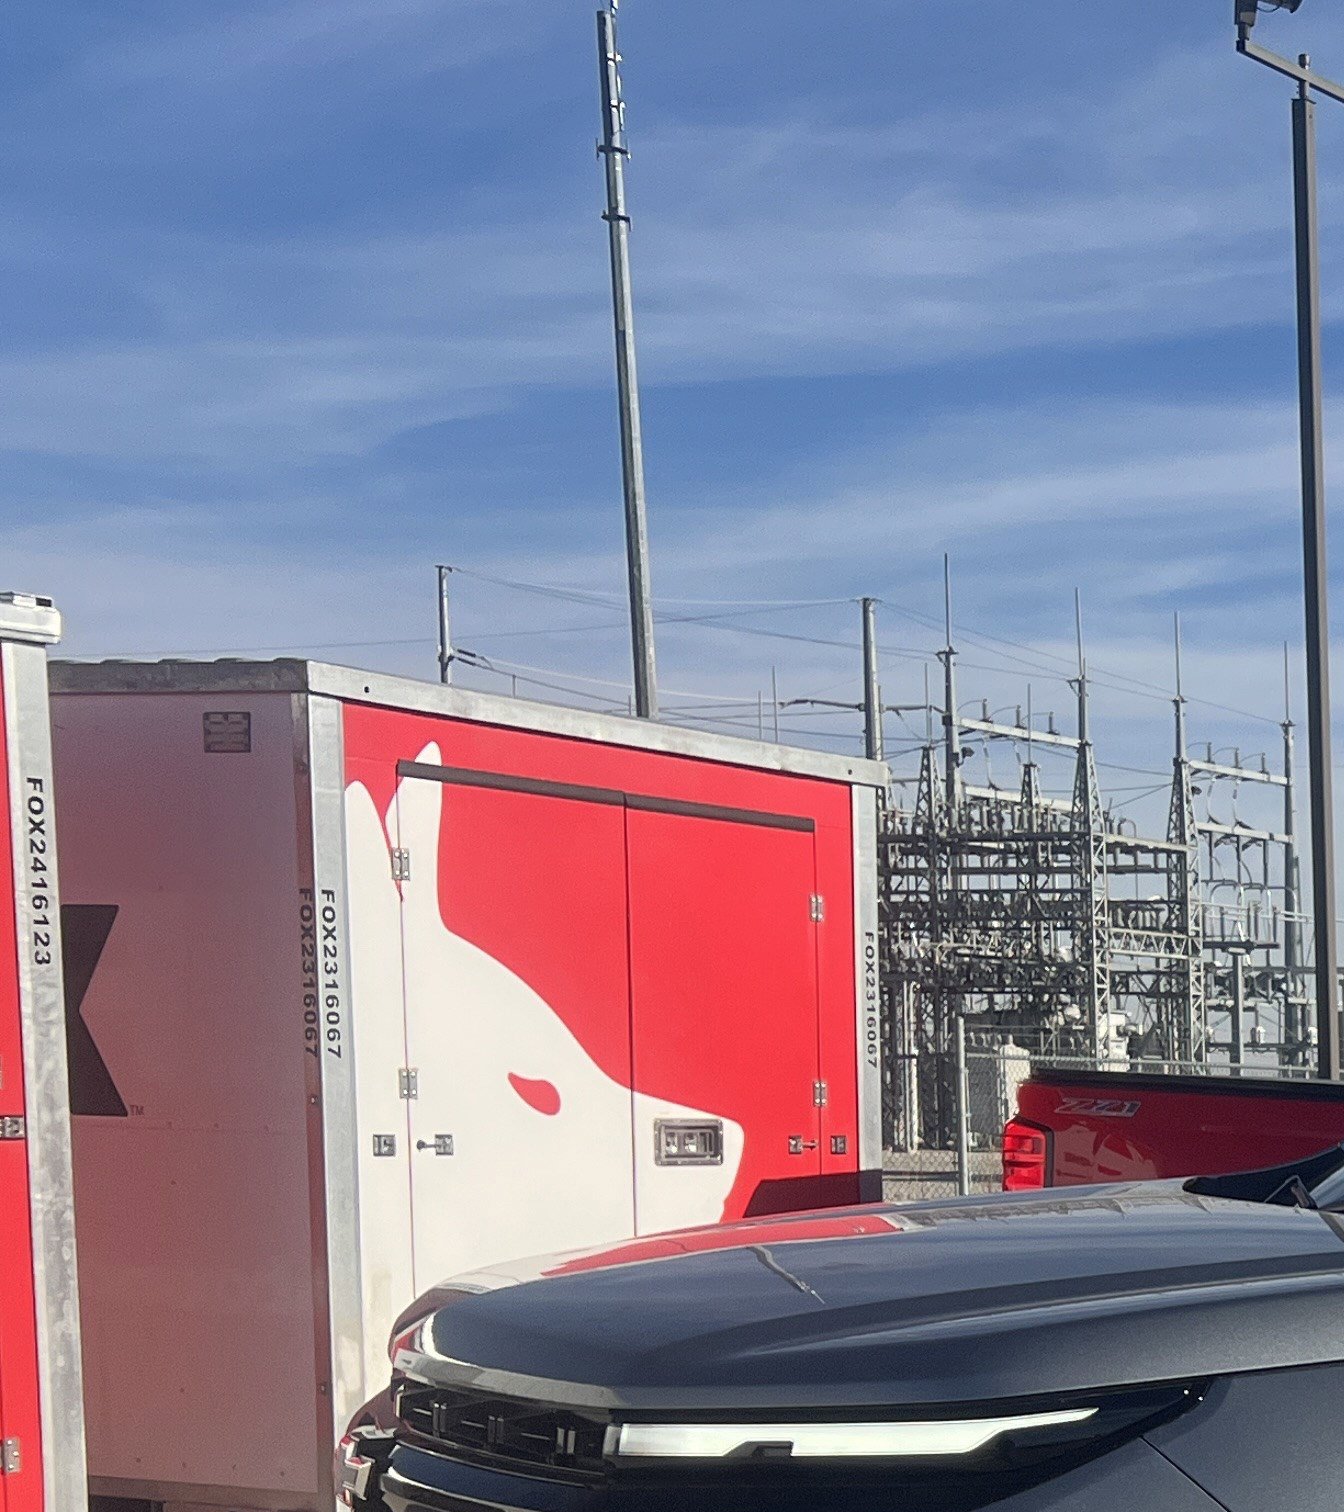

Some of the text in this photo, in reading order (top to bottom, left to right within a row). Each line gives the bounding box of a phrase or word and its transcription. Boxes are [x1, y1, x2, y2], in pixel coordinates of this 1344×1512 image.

[26, 777, 52, 966] FOX2416123
[299, 888, 319, 1059] FOX2316067
[321, 889, 342, 1059] FOX2316067
[865, 931, 878, 1069] FOX2316067
